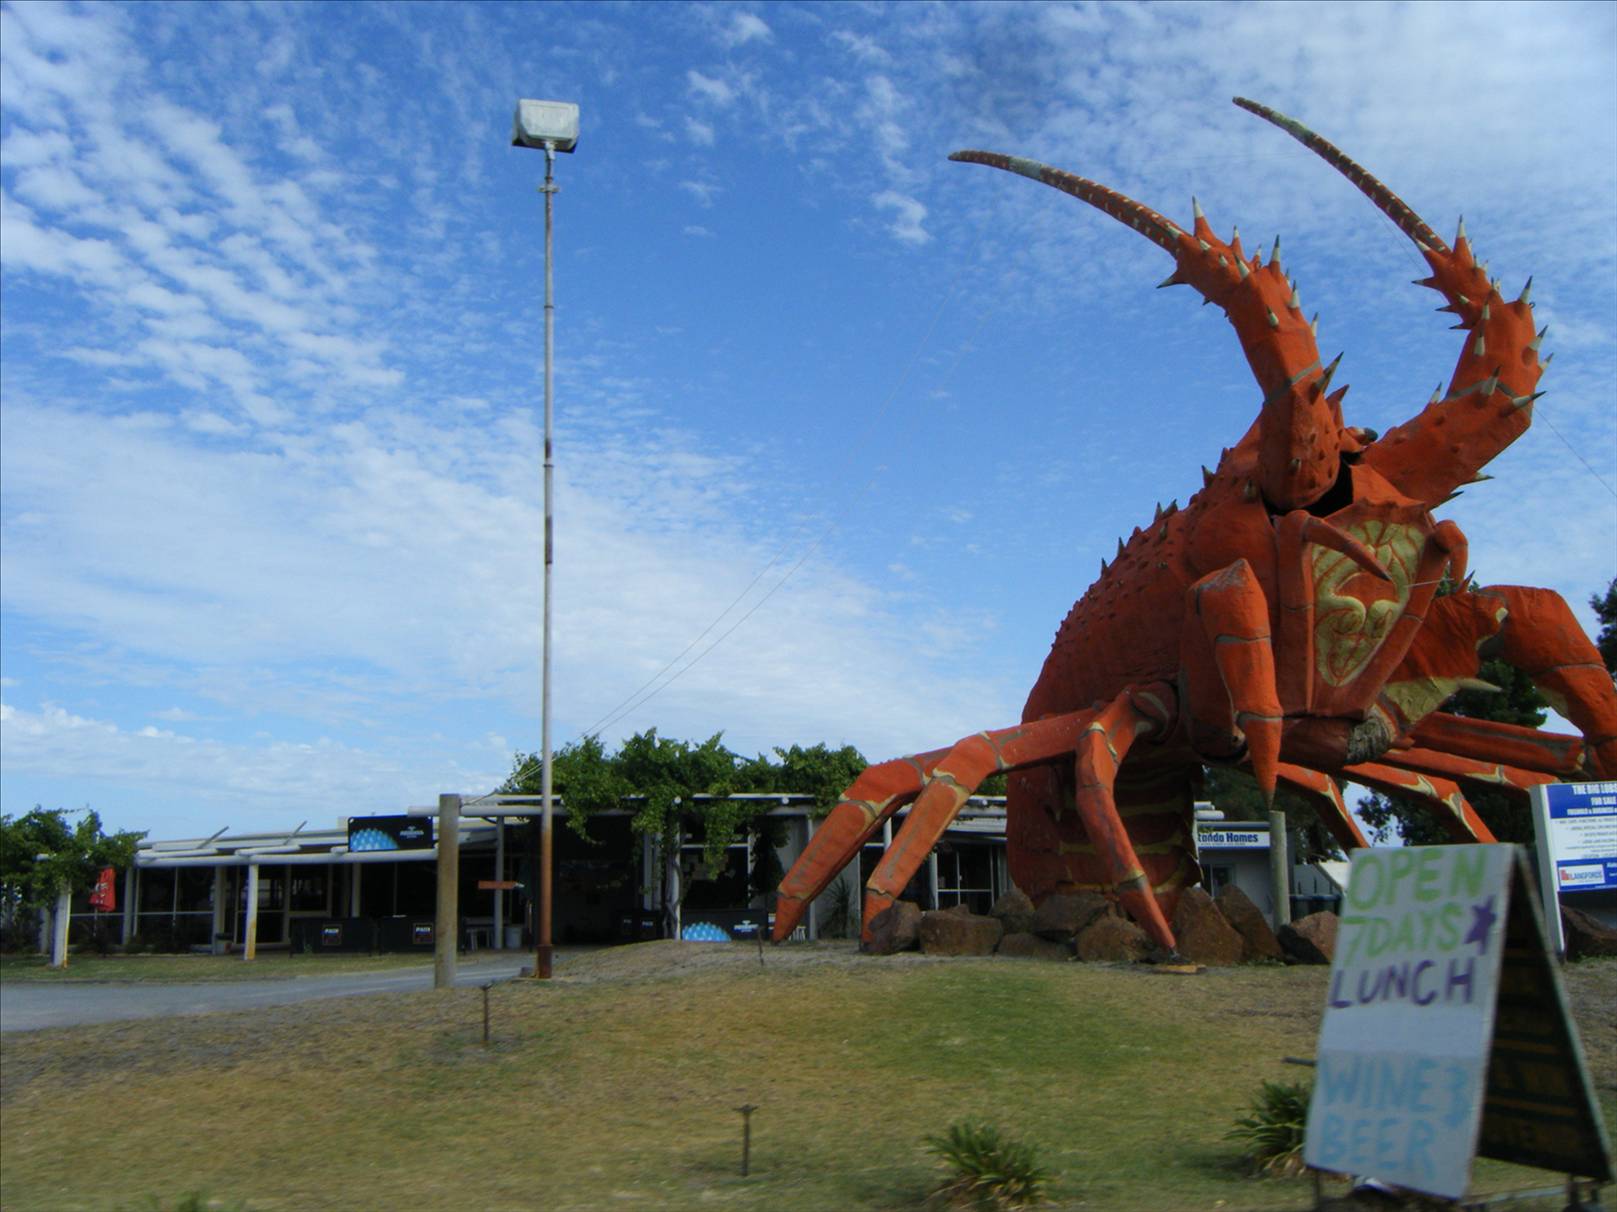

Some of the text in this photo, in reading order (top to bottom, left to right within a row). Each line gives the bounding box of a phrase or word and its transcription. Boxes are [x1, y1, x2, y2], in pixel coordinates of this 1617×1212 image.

[1226, 832, 1258, 843] Homes
[1345, 848, 1487, 911] OPEN
[1329, 956, 1476, 1009] LUNCH
[1318, 1055, 1439, 1113] WINE
[1316, 1114, 1438, 1182] BEER
